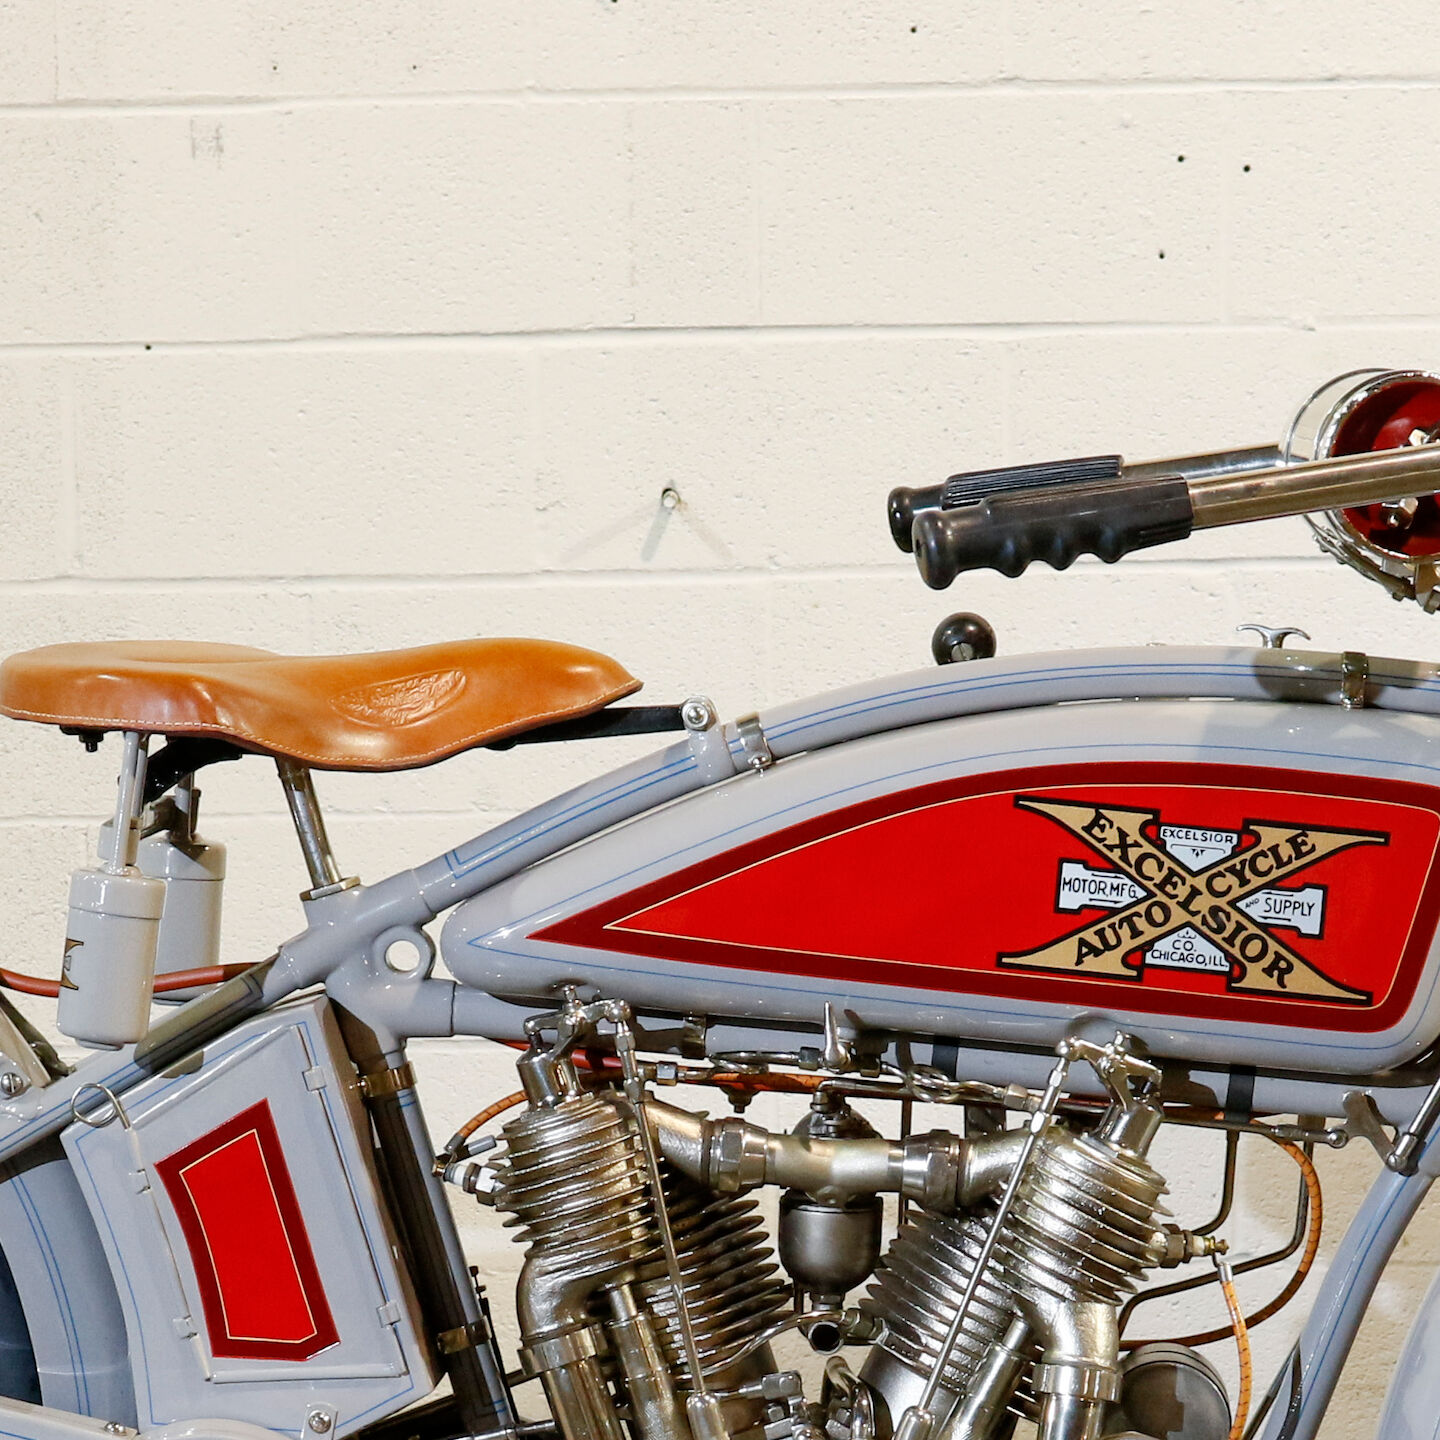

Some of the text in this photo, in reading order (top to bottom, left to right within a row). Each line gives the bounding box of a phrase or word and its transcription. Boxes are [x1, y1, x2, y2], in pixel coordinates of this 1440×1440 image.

[1162, 828, 1234, 844] EXCELSIOR
[1074, 830, 1317, 966] AUTO CYCLE
[1082, 809, 1294, 988] EXCELSIOR
[1263, 897, 1316, 917] SUPPLY
[1172, 939, 1197, 952] CO.
